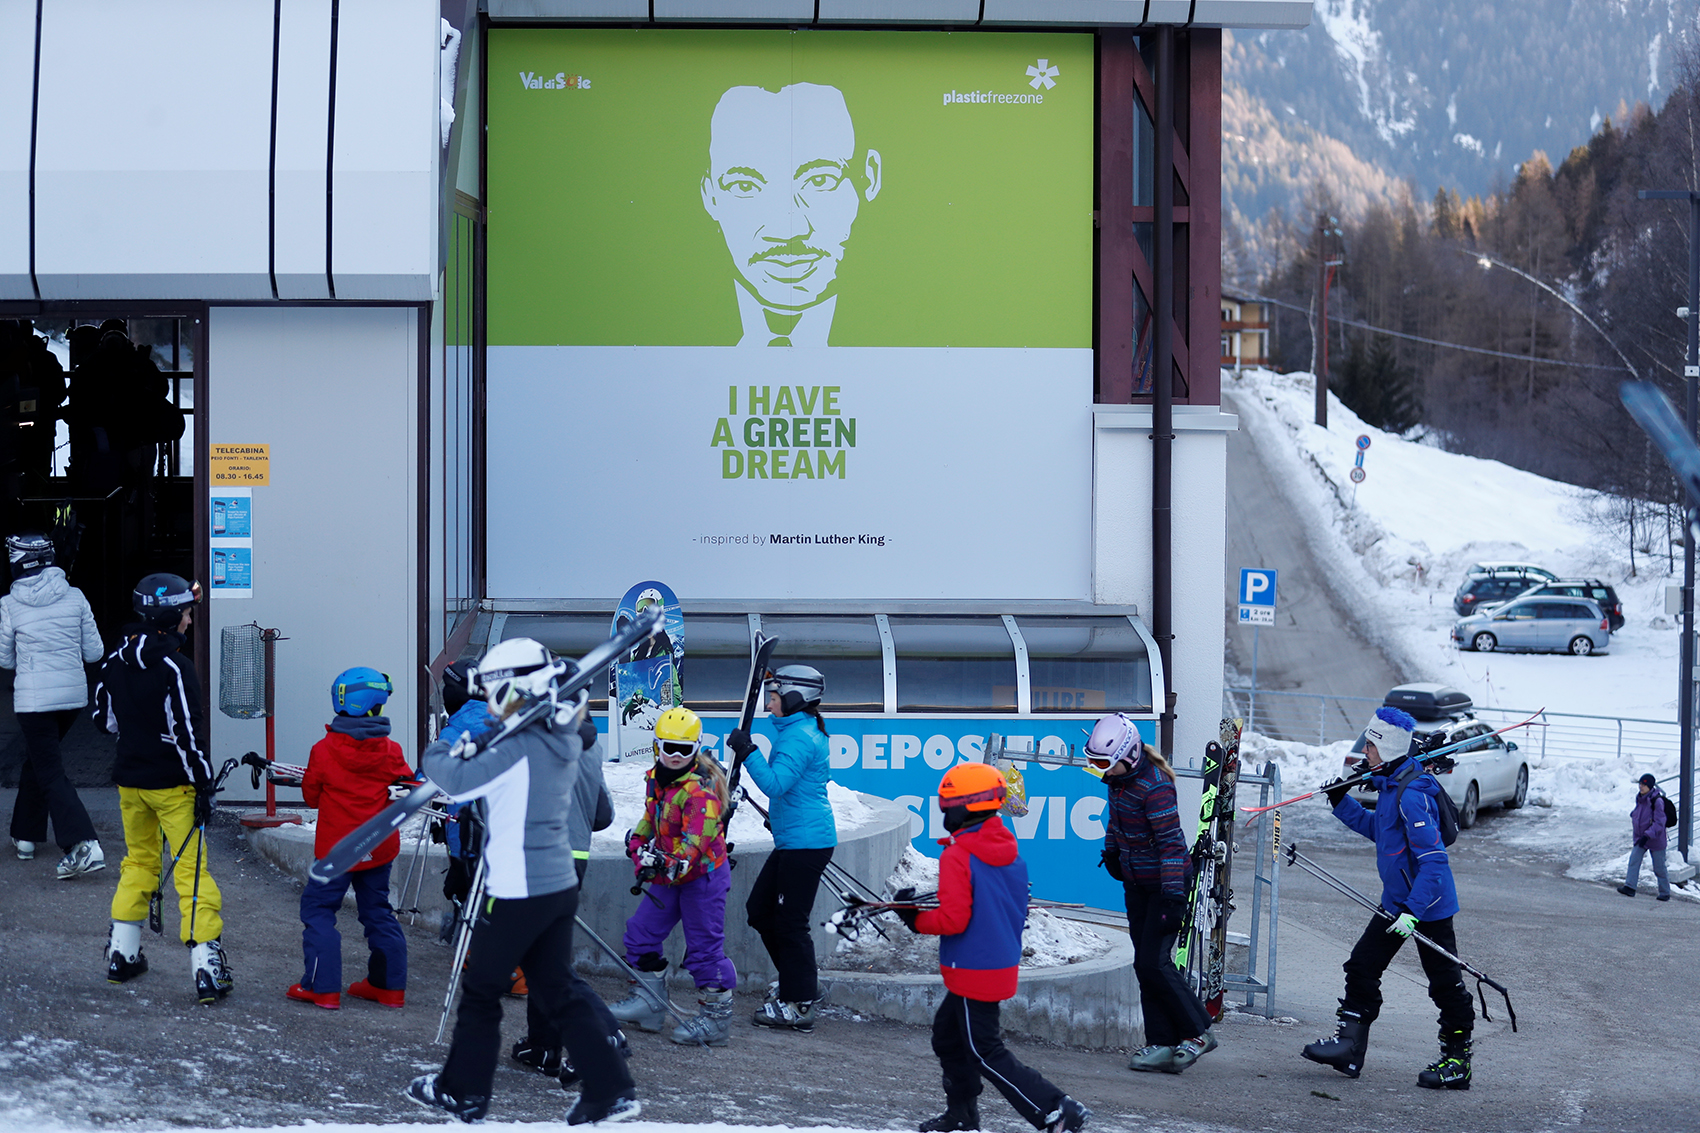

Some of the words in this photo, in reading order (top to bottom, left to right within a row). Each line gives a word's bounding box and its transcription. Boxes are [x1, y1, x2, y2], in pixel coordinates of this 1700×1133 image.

[519, 71, 543, 90] Val
[544, 79, 555, 89] di
[555, 72, 592, 90] Sole
[943, 90, 1043, 105] plasticfreezone
[729, 385, 737, 415] I
[749, 385, 841, 415] HAVE
[710, 417, 735, 447] A
[743, 417, 856, 447] GREEN
[722, 449, 846, 479] DREAM
[700, 533, 749, 546] inspired
[752, 533, 767, 546] by
[769, 533, 812, 544] Martin
[814, 533, 856, 544] Luther
[858, 533, 886, 546] King
[1246, 572, 1269, 602] P
